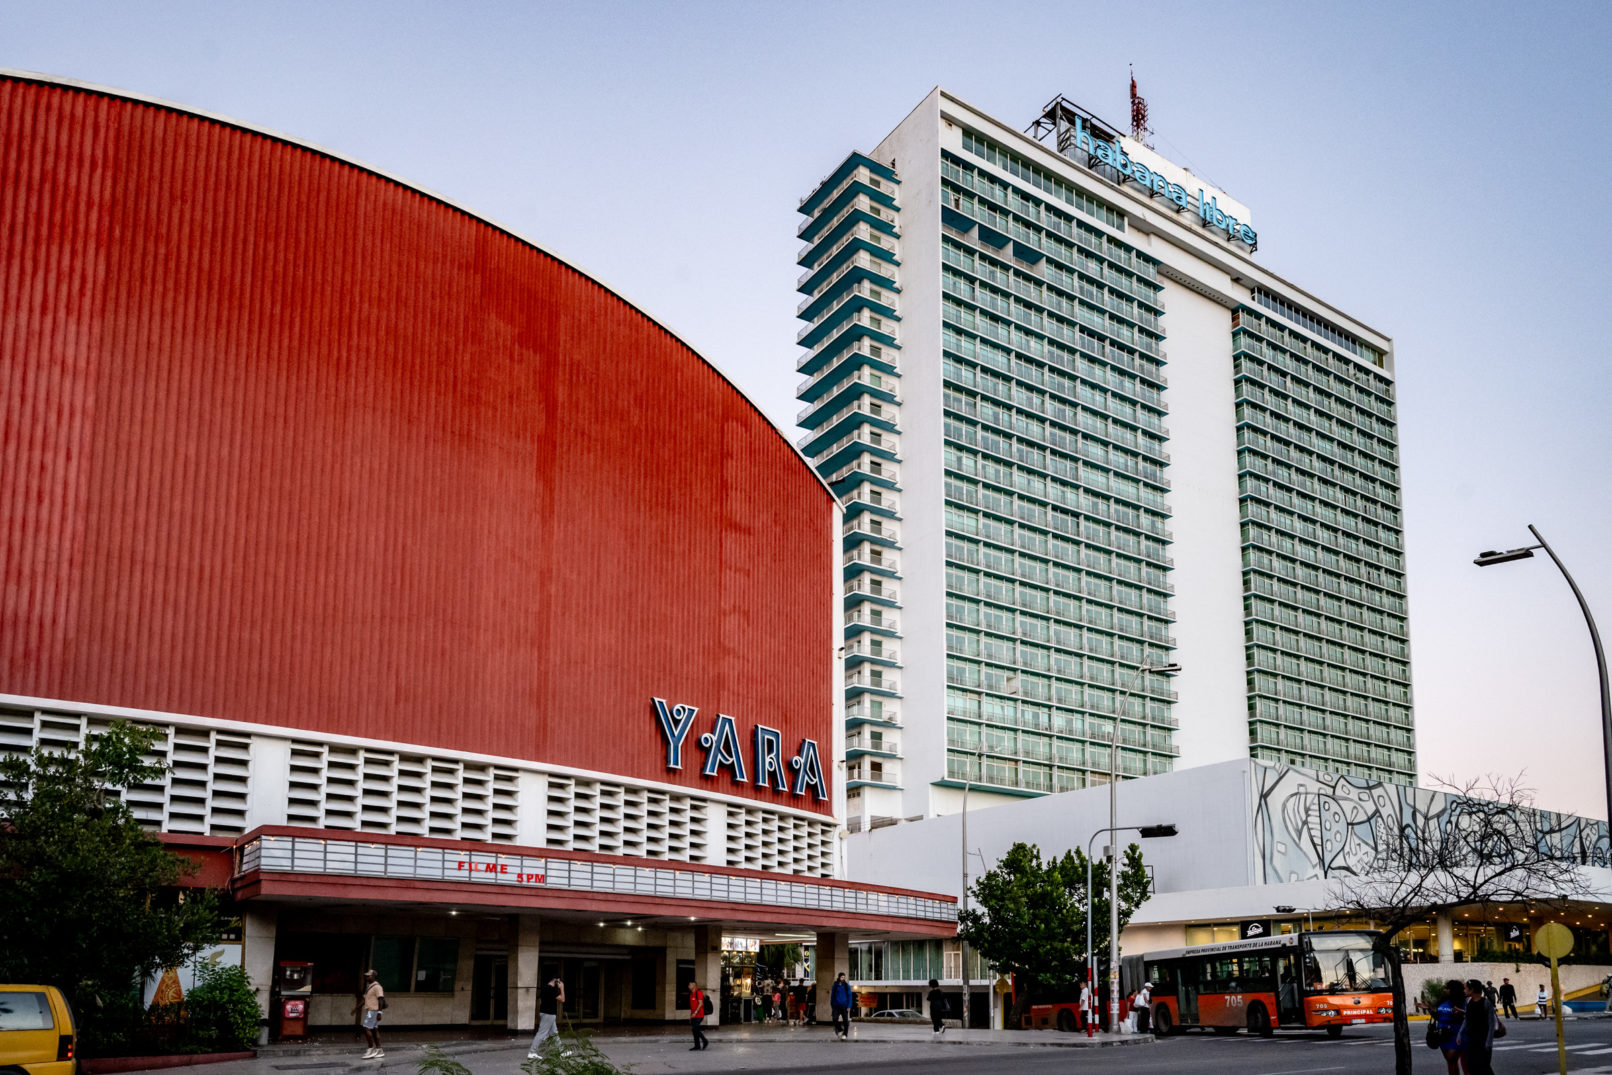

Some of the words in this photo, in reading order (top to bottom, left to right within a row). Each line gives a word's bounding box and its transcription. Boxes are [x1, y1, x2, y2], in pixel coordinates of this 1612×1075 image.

[1074, 115, 1188, 208] habana
[1198, 188, 1257, 245] libre
[651, 696, 829, 801] YARA
[457, 861, 509, 874] FILME
[1228, 942, 1252, 950] TRANSPORTE
[1224, 995, 1243, 1008] 705
